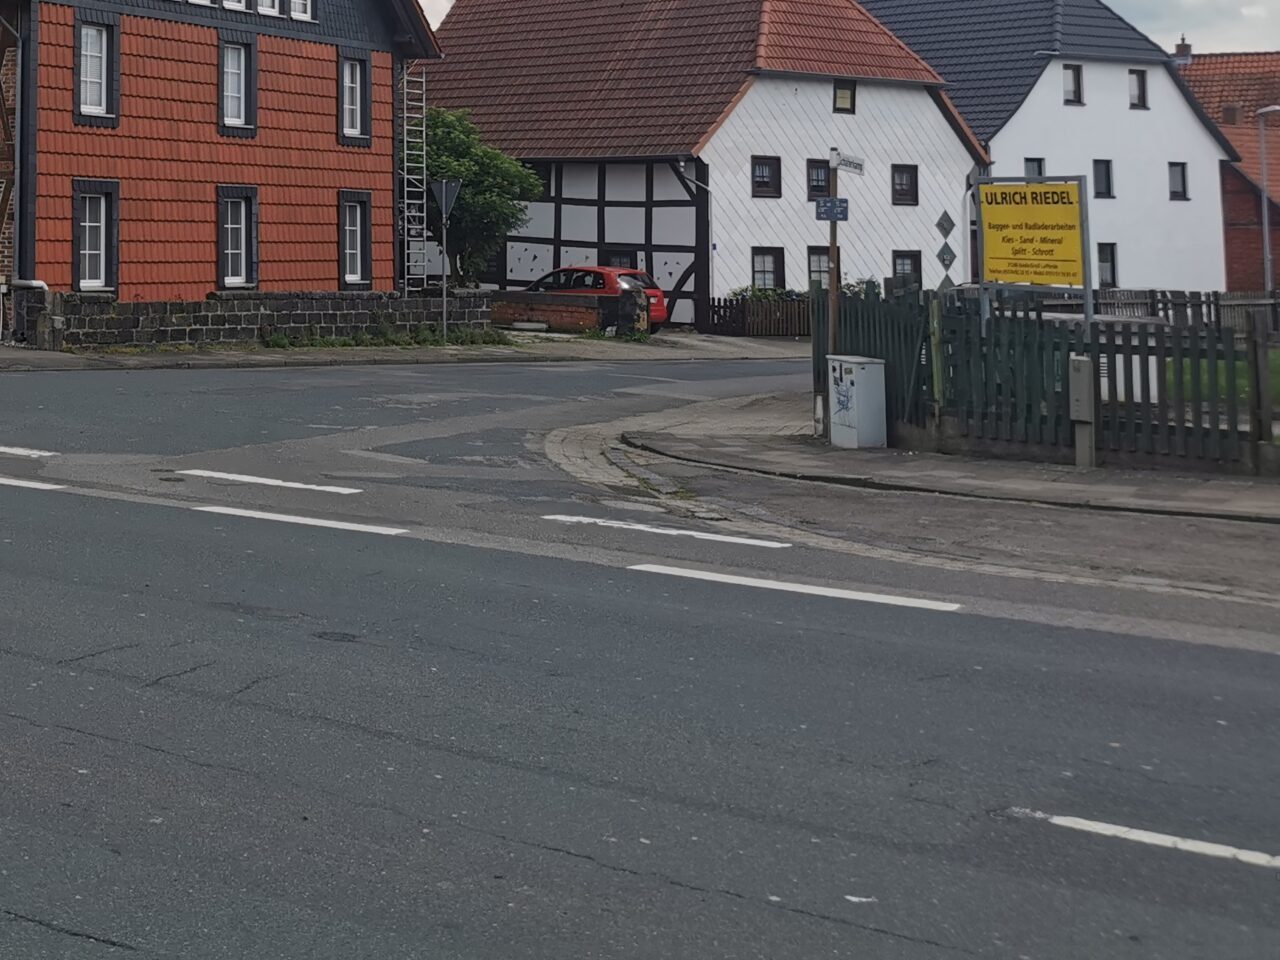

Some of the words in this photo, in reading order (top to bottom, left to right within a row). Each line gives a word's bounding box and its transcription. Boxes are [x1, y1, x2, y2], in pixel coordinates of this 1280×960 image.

[985, 191, 1028, 205] ULRICH
[1030, 191, 1074, 205] RIEDEL
[988, 222, 1010, 231] Bagger-
[1025, 222, 1076, 231] Radladerarbeiten
[1001, 236, 1015, 244] Kies
[1019, 236, 1035, 244] Sand
[1039, 236, 1064, 244] Mineral
[1011, 247, 1027, 256] Splitt
[1031, 247, 1055, 256] Schrott
